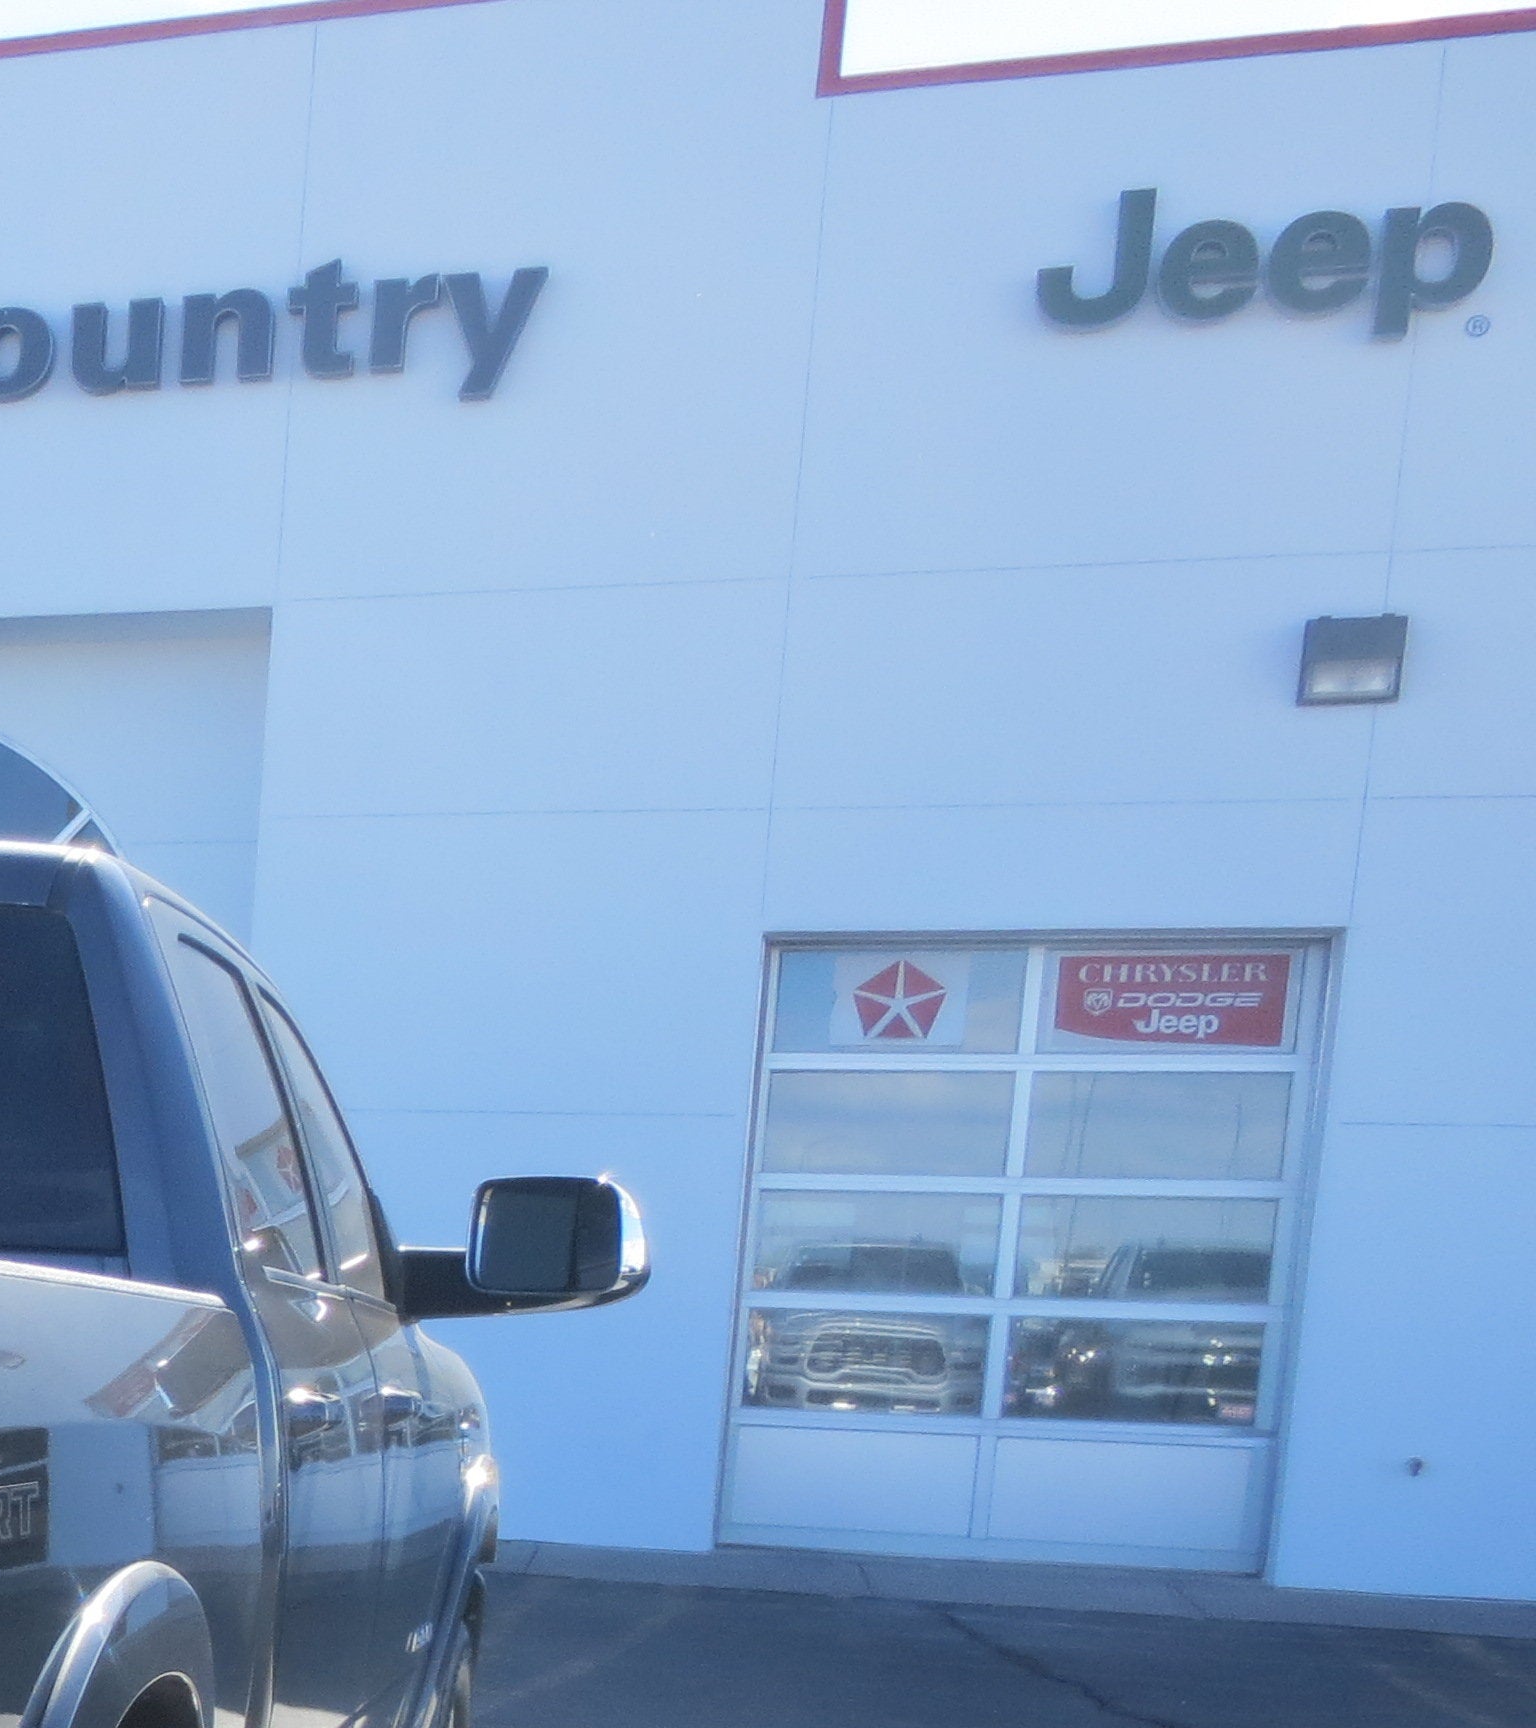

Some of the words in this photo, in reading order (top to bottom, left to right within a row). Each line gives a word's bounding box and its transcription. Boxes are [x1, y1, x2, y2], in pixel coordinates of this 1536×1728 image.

[1036, 188, 1493, 341] Jeep
[1079, 962, 1269, 983] CHRYSLER
[1117, 992, 1264, 1008] DODGE
[1132, 1008, 1219, 1039] Jeep
